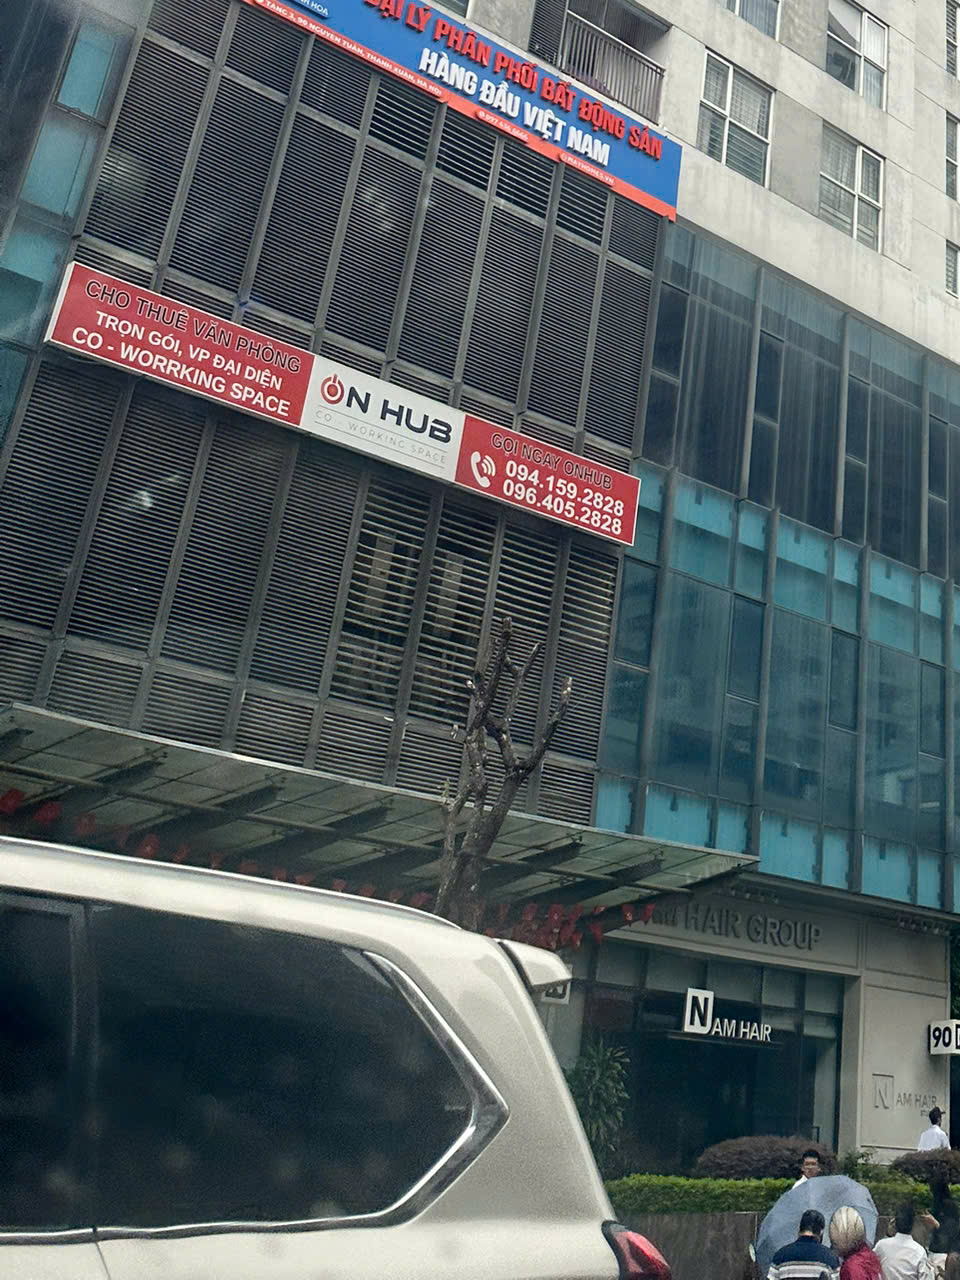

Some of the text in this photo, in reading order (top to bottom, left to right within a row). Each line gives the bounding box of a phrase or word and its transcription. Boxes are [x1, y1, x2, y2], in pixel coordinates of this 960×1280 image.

[311, 1, 329, 16] HOA
[405, 3, 432, 32] LÝ
[433, 18, 492, 67] PHÂN
[494, 52, 539, 93] PHỐI
[541, 77, 577, 112] BẤT
[578, 97, 625, 140] ĐỘNG
[628, 124, 663, 161] SẢN
[418, 48, 611, 167] HÀNG ĐẦU VIỆT NAM
[85, 280, 301, 374] CHO THUÊ VĂN PHÒNG
[95, 310, 283, 392] TRỌN GÓI, VP ĐẠI DIỆN
[71, 327, 103, 351] CO
[119, 341, 226, 394] WORRKING
[229, 383, 291, 417] SPACE
[320, 373, 453, 444] ON HUB
[347, 422, 405, 449] WORKING
[410, 444, 446, 464] SPACE
[490, 433, 613, 490] GỌI NGAY ONHUB
[503, 479, 622, 535] 096.405.2828
[506, 460, 625, 517] 094.159.2828
[684, 903, 741, 939] HAIR
[746, 911, 823, 951] GROUP
[739, 1021, 772, 1042] HAIR
[932, 1026, 952, 1048] 90
